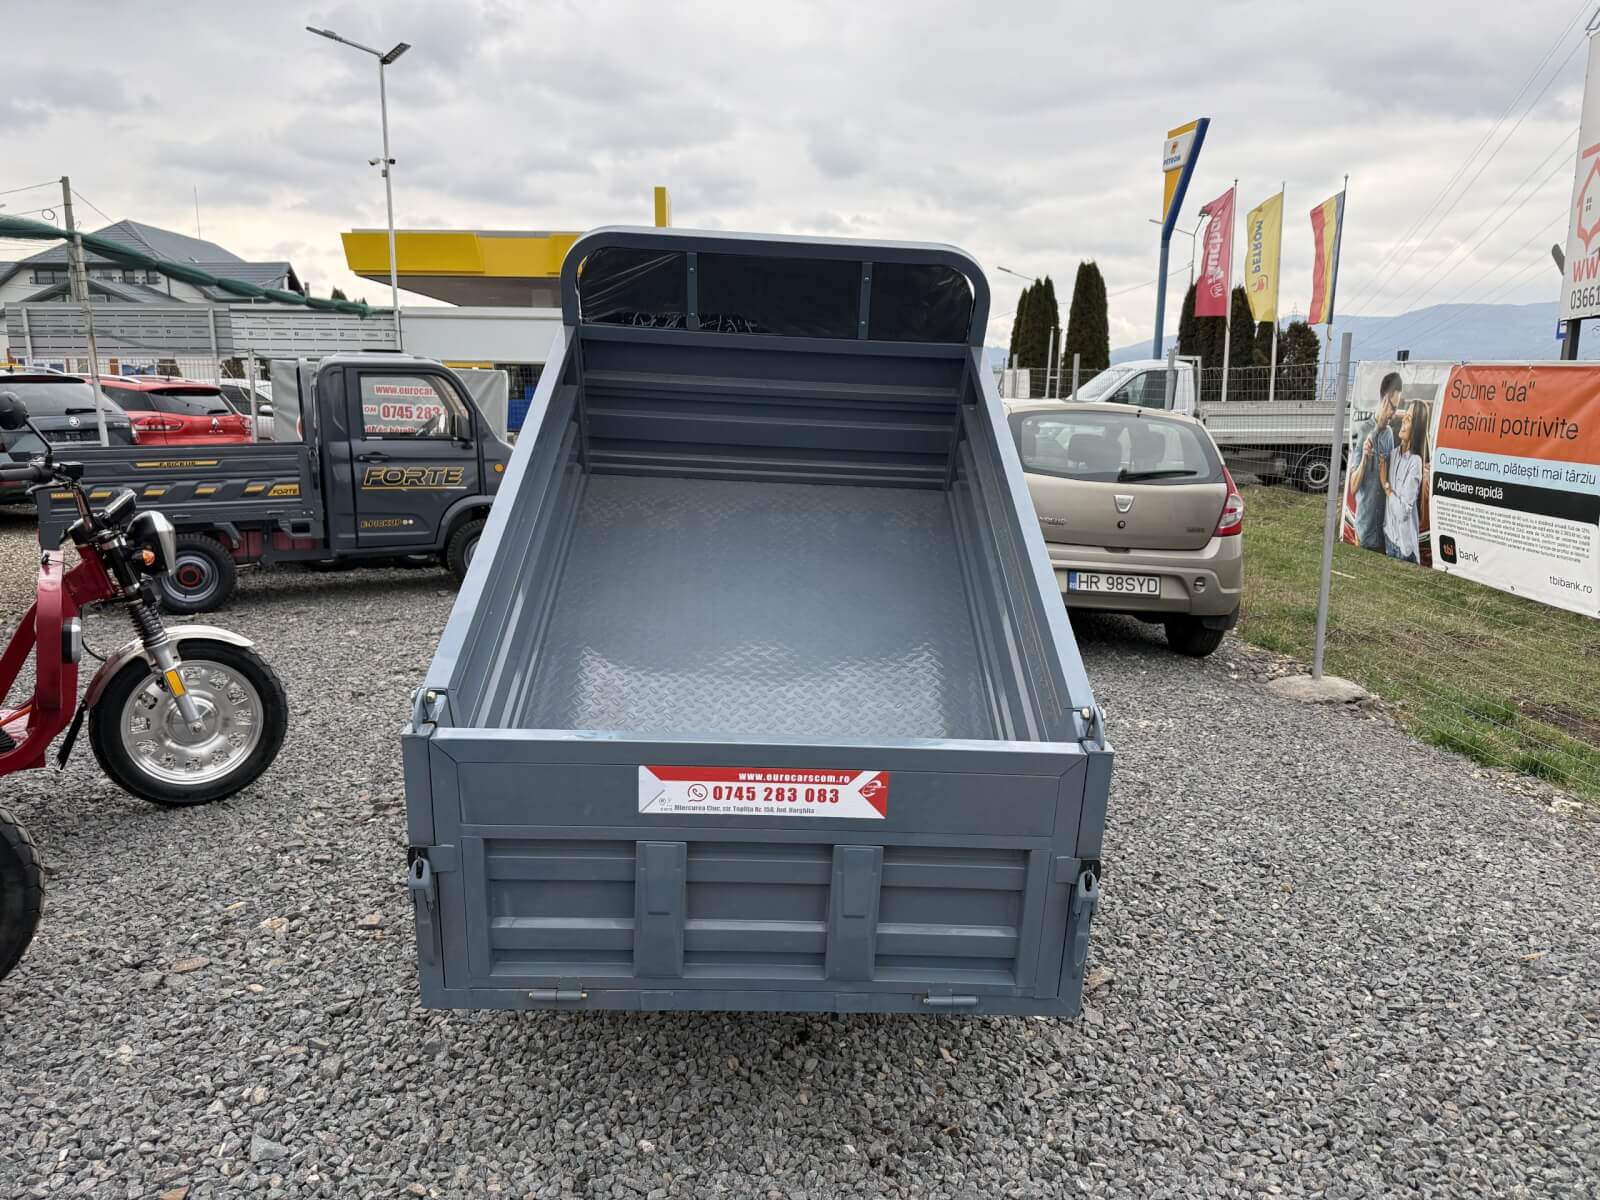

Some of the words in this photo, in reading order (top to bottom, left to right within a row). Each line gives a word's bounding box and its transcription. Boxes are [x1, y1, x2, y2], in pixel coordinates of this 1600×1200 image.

[1570, 286, 1600, 310] 03661
[375, 386, 433, 396] www.eurocar
[1451, 378, 1496, 404] Spune
[1501, 380, 1536, 402] "da"
[382, 404, 413, 419] 0745
[1445, 412, 1497, 436] mașinii
[1500, 416, 1579, 440] potrivite
[363, 466, 465, 486] FORTE
[1439, 453, 1473, 470] Cumperi
[1474, 460, 1501, 473] acum,
[1503, 462, 1539, 478] plătești
[1542, 467, 1562, 481] mai
[1565, 469, 1596, 485] târziu
[272, 487, 298, 495] FORTE
[1437, 477, 1474, 493] Aprobare
[1475, 487, 1503, 500] rapidă
[1443, 544, 1454, 556] tbi
[1458, 548, 1479, 563] bank
[1078, 574, 1100, 590] HR
[1106, 576, 1158, 594] 98SYD
[1549, 575, 1593, 594] tbibank.ro
[738, 772, 851, 784] www.eurocarscom.ro
[713, 786, 756, 801] 0745
[763, 787, 797, 802] 283
[805, 788, 840, 803] 083
